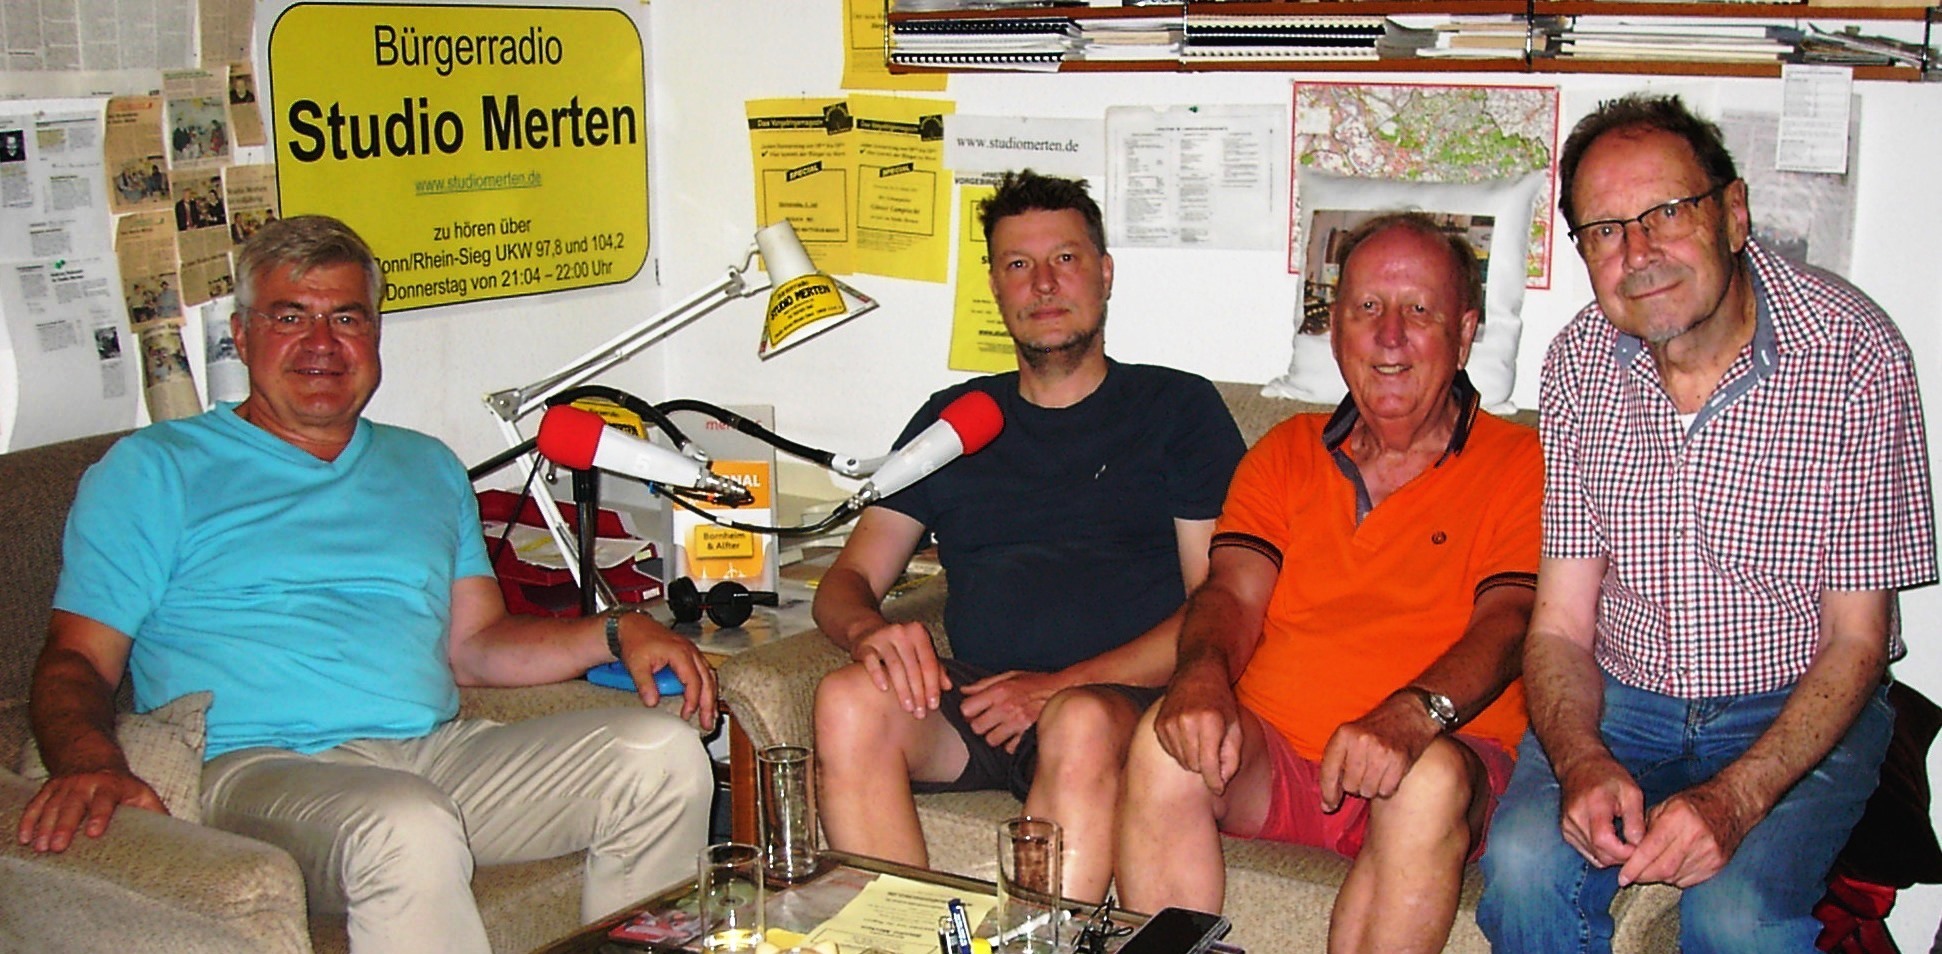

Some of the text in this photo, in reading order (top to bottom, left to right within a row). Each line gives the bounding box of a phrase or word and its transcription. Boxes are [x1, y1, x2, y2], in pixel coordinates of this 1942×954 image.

[374, 24, 563, 77] Bürgerradio
[288, 94, 637, 163] Studio Merten
[957, 136, 1079, 152] www.studiomerten.de
[415, 169, 542, 196] www.studiomerten.de
[432, 217, 532, 241] zu hören über
[495, 241, 533, 261] UKW
[535, 238, 562, 258] 97,8
[565, 236, 589, 254] und
[592, 232, 624, 251] 104,2
[385, 277, 467, 301] Donnerstag
[471, 275, 498, 290] von
[501, 267, 541, 288] 21:04
[555, 261, 589, 281] 22:00
[592, 258, 613, 276] Uhr
[794, 284, 831, 301] MERTEN
[703, 531, 746, 541] Bornheim
[707, 542, 714, 550] &
